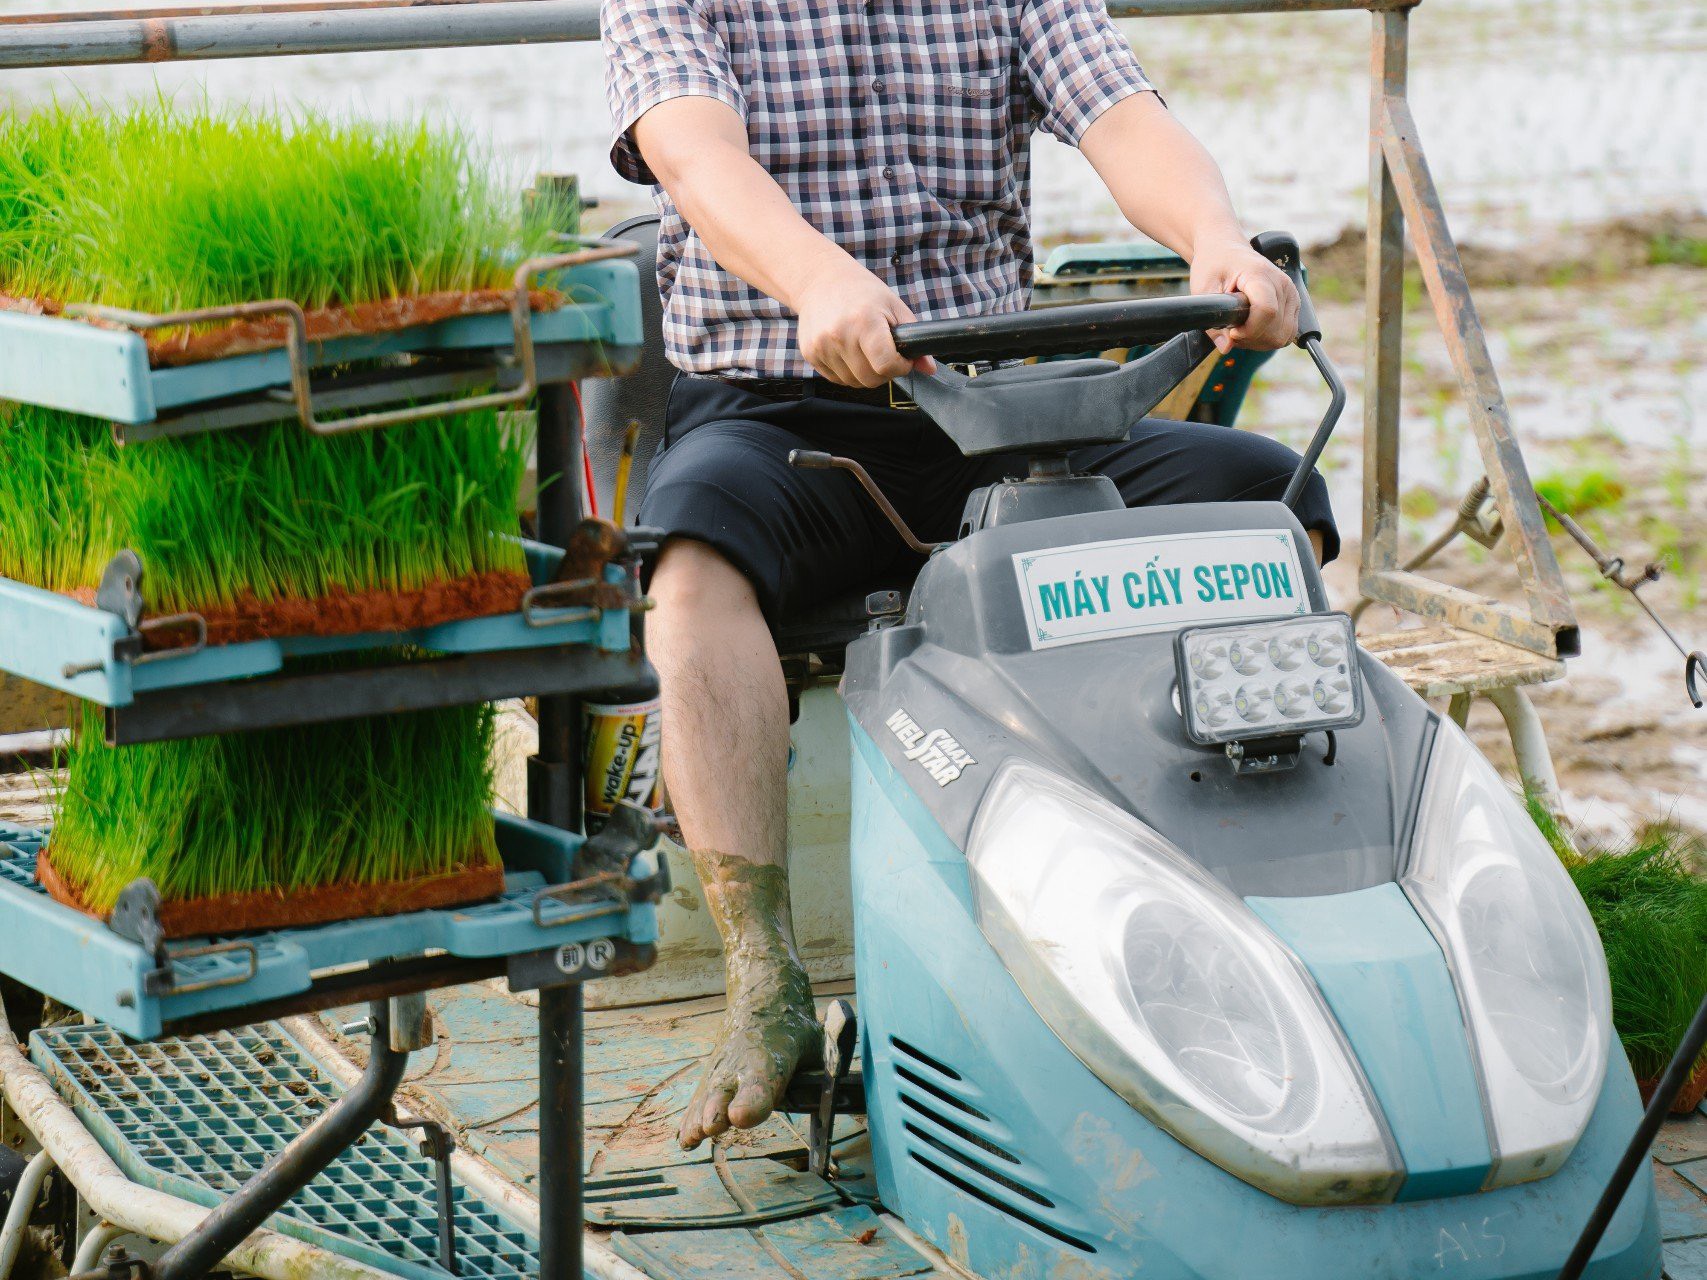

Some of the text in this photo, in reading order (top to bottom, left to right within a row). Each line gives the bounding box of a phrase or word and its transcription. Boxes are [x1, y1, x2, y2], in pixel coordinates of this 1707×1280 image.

[1038, 554, 1294, 622] MÁY CẤY SEPON
[603, 723, 640, 803] wake-up
[594, 944, 609, 961] R
